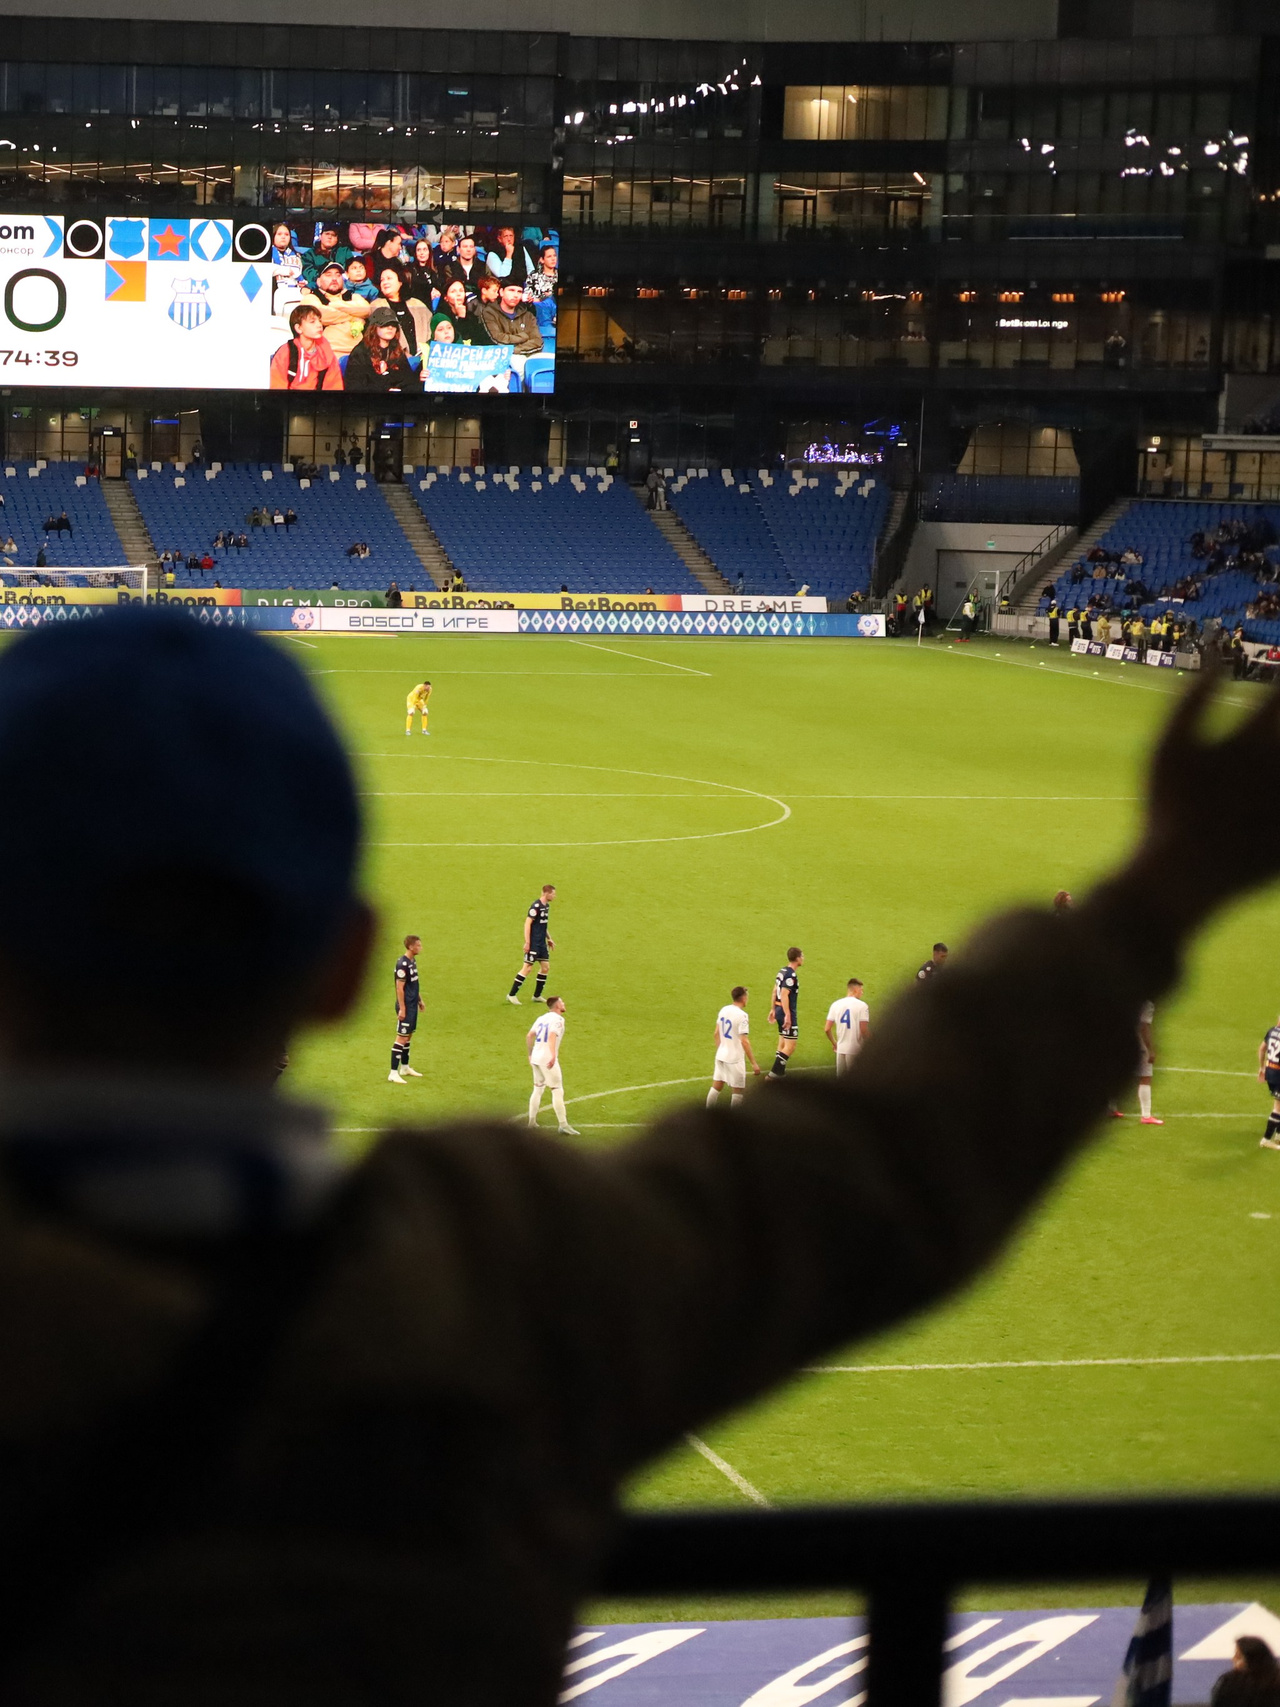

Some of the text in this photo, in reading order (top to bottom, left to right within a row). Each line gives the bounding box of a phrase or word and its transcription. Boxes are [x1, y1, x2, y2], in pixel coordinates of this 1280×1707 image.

[431, 343, 484, 361] АНДРЕЙ
[117, 592, 217, 606] BetBoom
[414, 595, 510, 609] BetBoom
[561, 597, 657, 611] BetBoom
[705, 600, 802, 613] DREAME
[349, 616, 414, 628] BOSCO
[442, 617, 489, 629] ИГРЕ
[840, 1009, 851, 1030] 4
[536, 1022, 550, 1043] 21
[720, 1016, 733, 1040] 12
